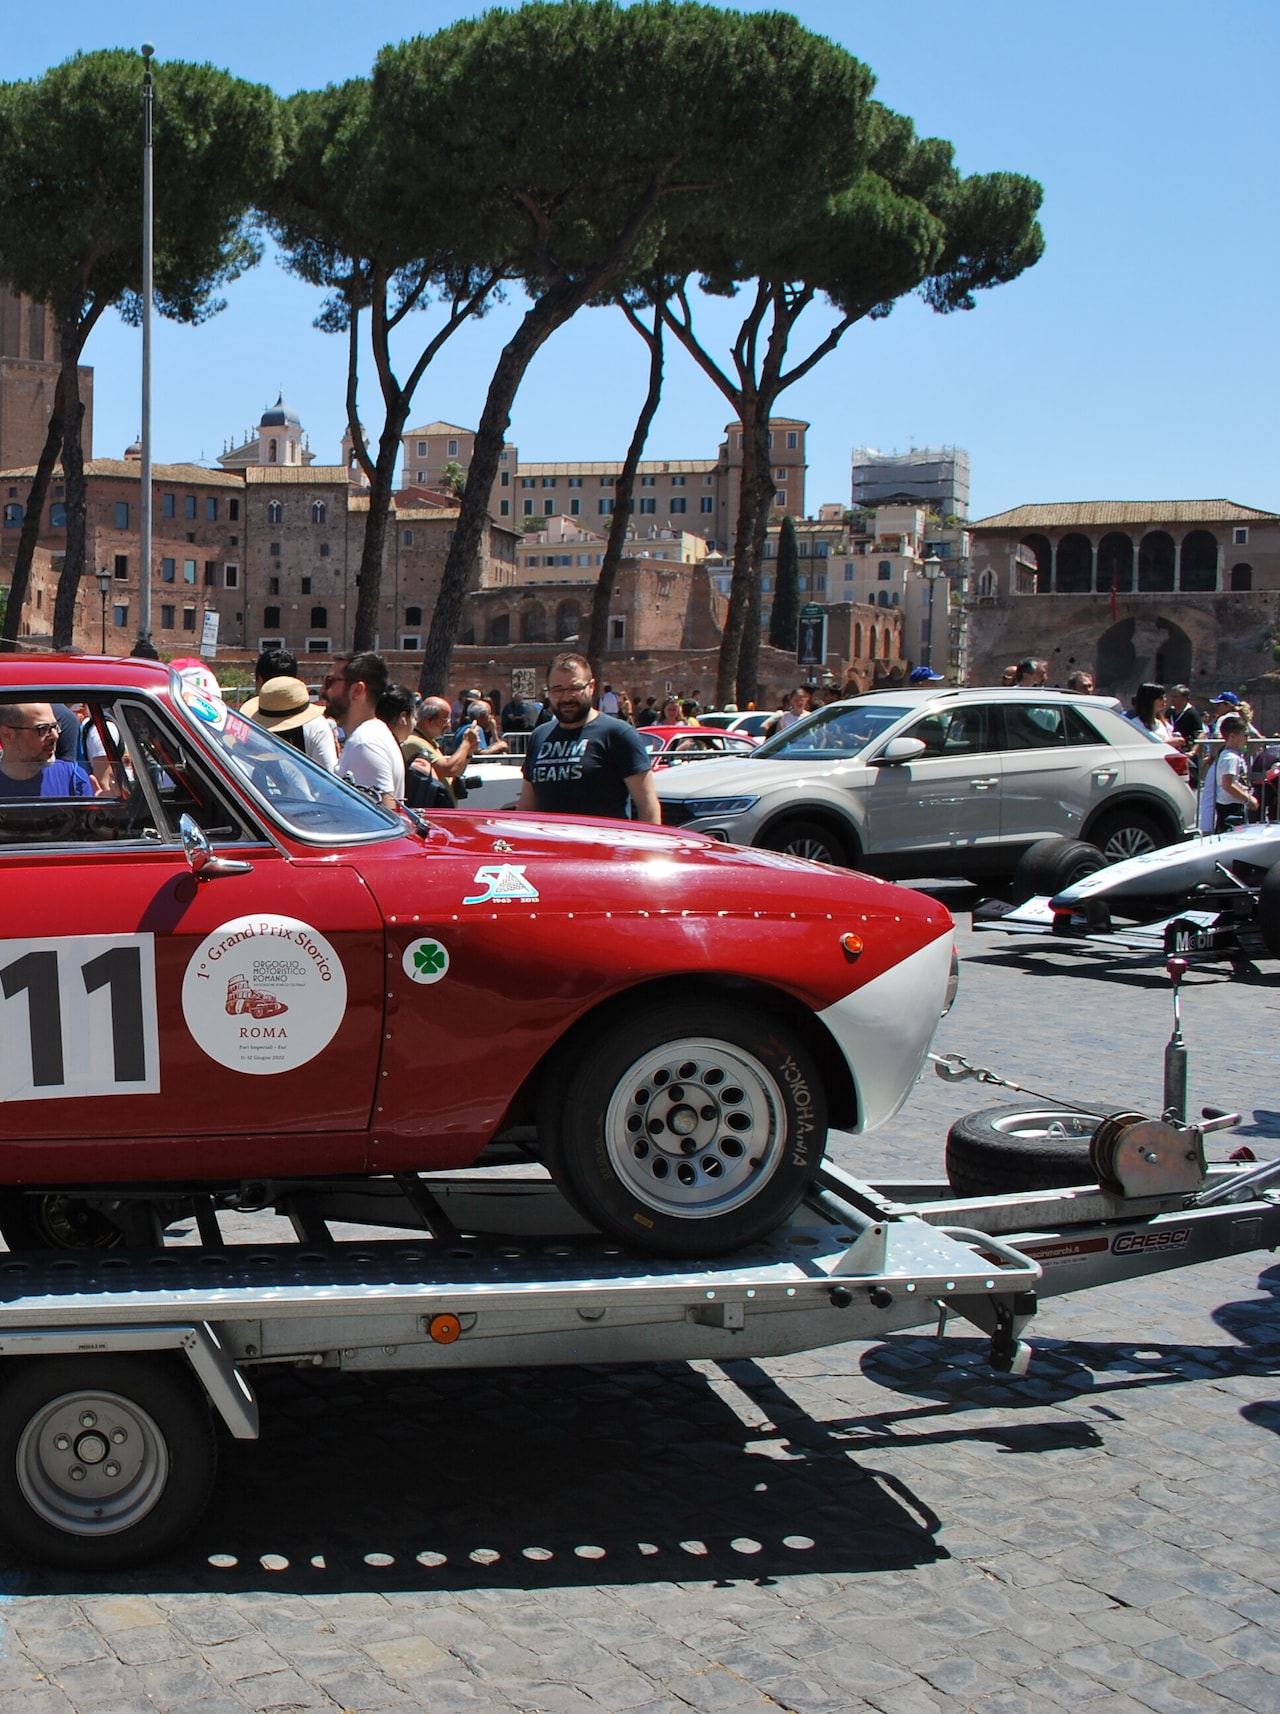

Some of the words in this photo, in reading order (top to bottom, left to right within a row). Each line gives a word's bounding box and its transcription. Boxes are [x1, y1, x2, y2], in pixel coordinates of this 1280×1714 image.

[537, 739, 589, 759] DNM
[532, 764, 583, 783] JEANS
[207, 923, 257, 961] Grand
[259, 922, 294, 940] Prix
[294, 932, 333, 983] Storico
[253, 960, 300, 968] ORGOGLIO
[253, 967, 307, 976] MOTORISTICO
[253, 974, 288, 983] ROMANO
[0, 946, 146, 1087] 11
[240, 1027, 288, 1038] ROMA
[779, 1055, 815, 1167] YOKOHAMA
[1116, 1229, 1192, 1251] CRESCI
